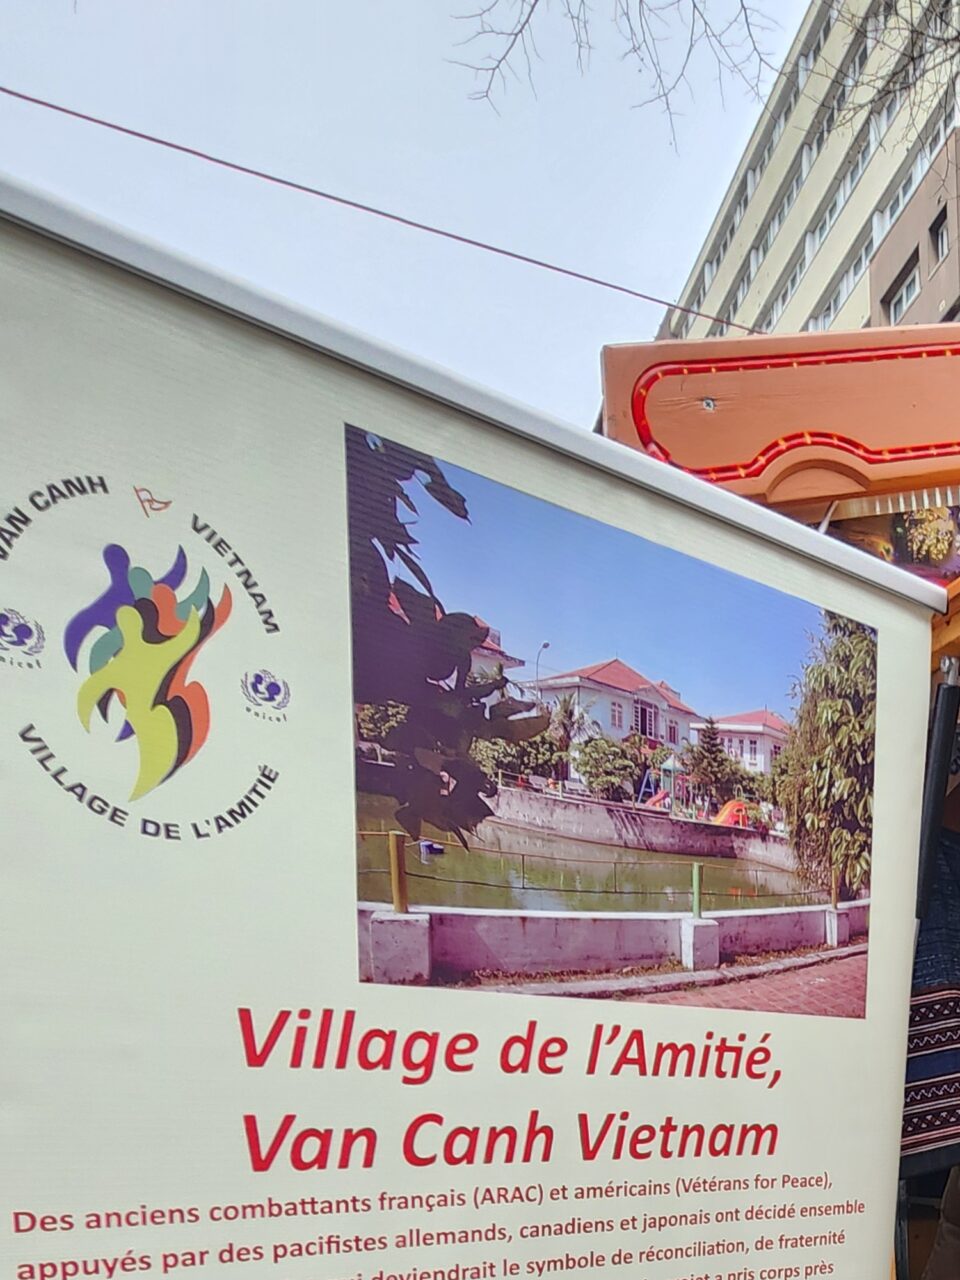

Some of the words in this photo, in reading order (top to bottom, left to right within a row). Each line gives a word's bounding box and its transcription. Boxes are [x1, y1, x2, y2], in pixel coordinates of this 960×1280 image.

[29, 475, 110, 512] CANH
[191, 514, 281, 635] VIETNAM
[18, 723, 130, 827] VILLAGE
[140, 818, 181, 841] DE
[191, 764, 280, 840] L'AMITIÉ
[238, 1007, 479, 1086] Village
[499, 1020, 568, 1075] de
[586, 1022, 784, 1089] l’Amitié,
[243, 1113, 377, 1173] Van
[401, 1109, 554, 1167] Canh
[578, 1110, 779, 1162] Vietnam
[13, 1212, 75, 1233] Des
[85, 1205, 200, 1229] anciens
[209, 1196, 372, 1222] combattants
[377, 1189, 466, 1212] français
[473, 1184, 543, 1210] (ARAC)
[549, 1185, 568, 1201] et
[574, 1179, 671, 1199] américains
[676, 1176, 749, 1197] (Vétérans
[754, 1174, 777, 1189] for
[782, 1171, 832, 1190] Peace),
[162, 1250, 210, 1274] par
[218, 1242, 264, 1264] des
[273, 1235, 388, 1264] pacifistes
[395, 1223, 512, 1248] allemands,
[520, 1217, 614, 1239] canadiens
[620, 1216, 638, 1231] et
[641, 1209, 710, 1233] japonais
[715, 1208, 740, 1223] ont
[745, 1203, 796, 1221] décidé
[800, 1199, 865, 1217] ensemble
